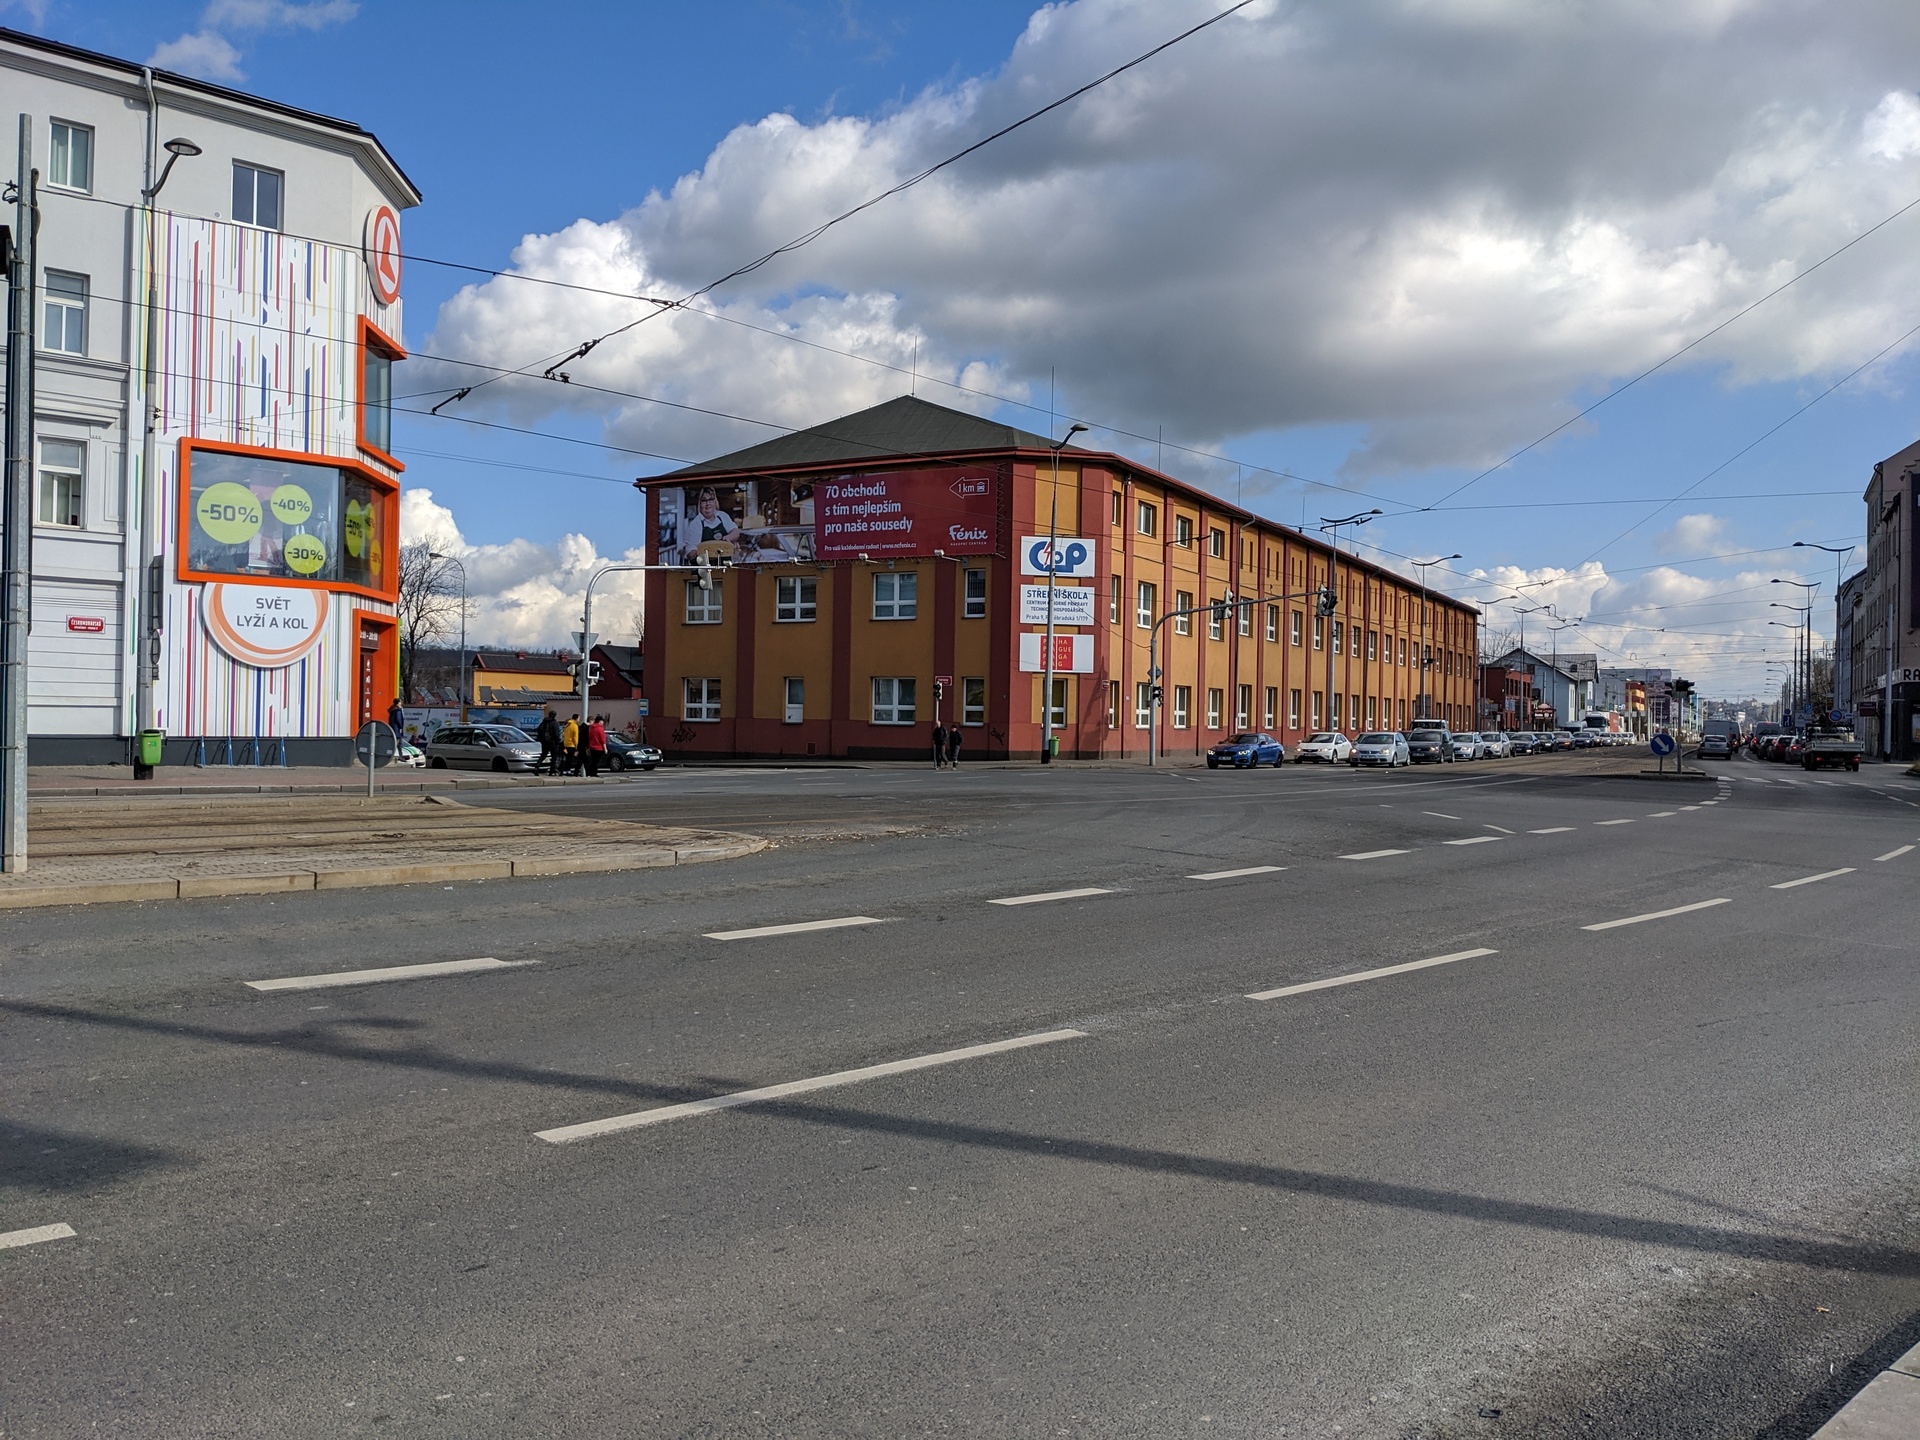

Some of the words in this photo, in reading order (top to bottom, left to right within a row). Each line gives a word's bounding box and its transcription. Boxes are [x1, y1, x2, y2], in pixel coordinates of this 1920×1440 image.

[826, 486, 839, 498] 70
[842, 481, 886, 497] obchodů
[958, 484, 961, 493] 1
[963, 483, 974, 492] km
[273, 499, 310, 512] -40%
[825, 506, 830, 516] s
[832, 503, 849, 515] tím
[852, 500, 901, 518] nejlepším
[201, 504, 258, 523] -50%
[825, 524, 842, 536] pro
[844, 519, 868, 532] naše
[870, 516, 912, 533] sousedy
[949, 525, 988, 540] Fénix
[288, 548, 323, 560] -30%
[1027, 588, 1060, 598] STŘENÍ
[1062, 589, 1088, 599] ŠKOLA
[256, 596, 291, 610] SVĚT
[237, 613, 266, 628] LYŽÍ
[269, 617, 279, 628] A
[283, 618, 308, 629] KOL
